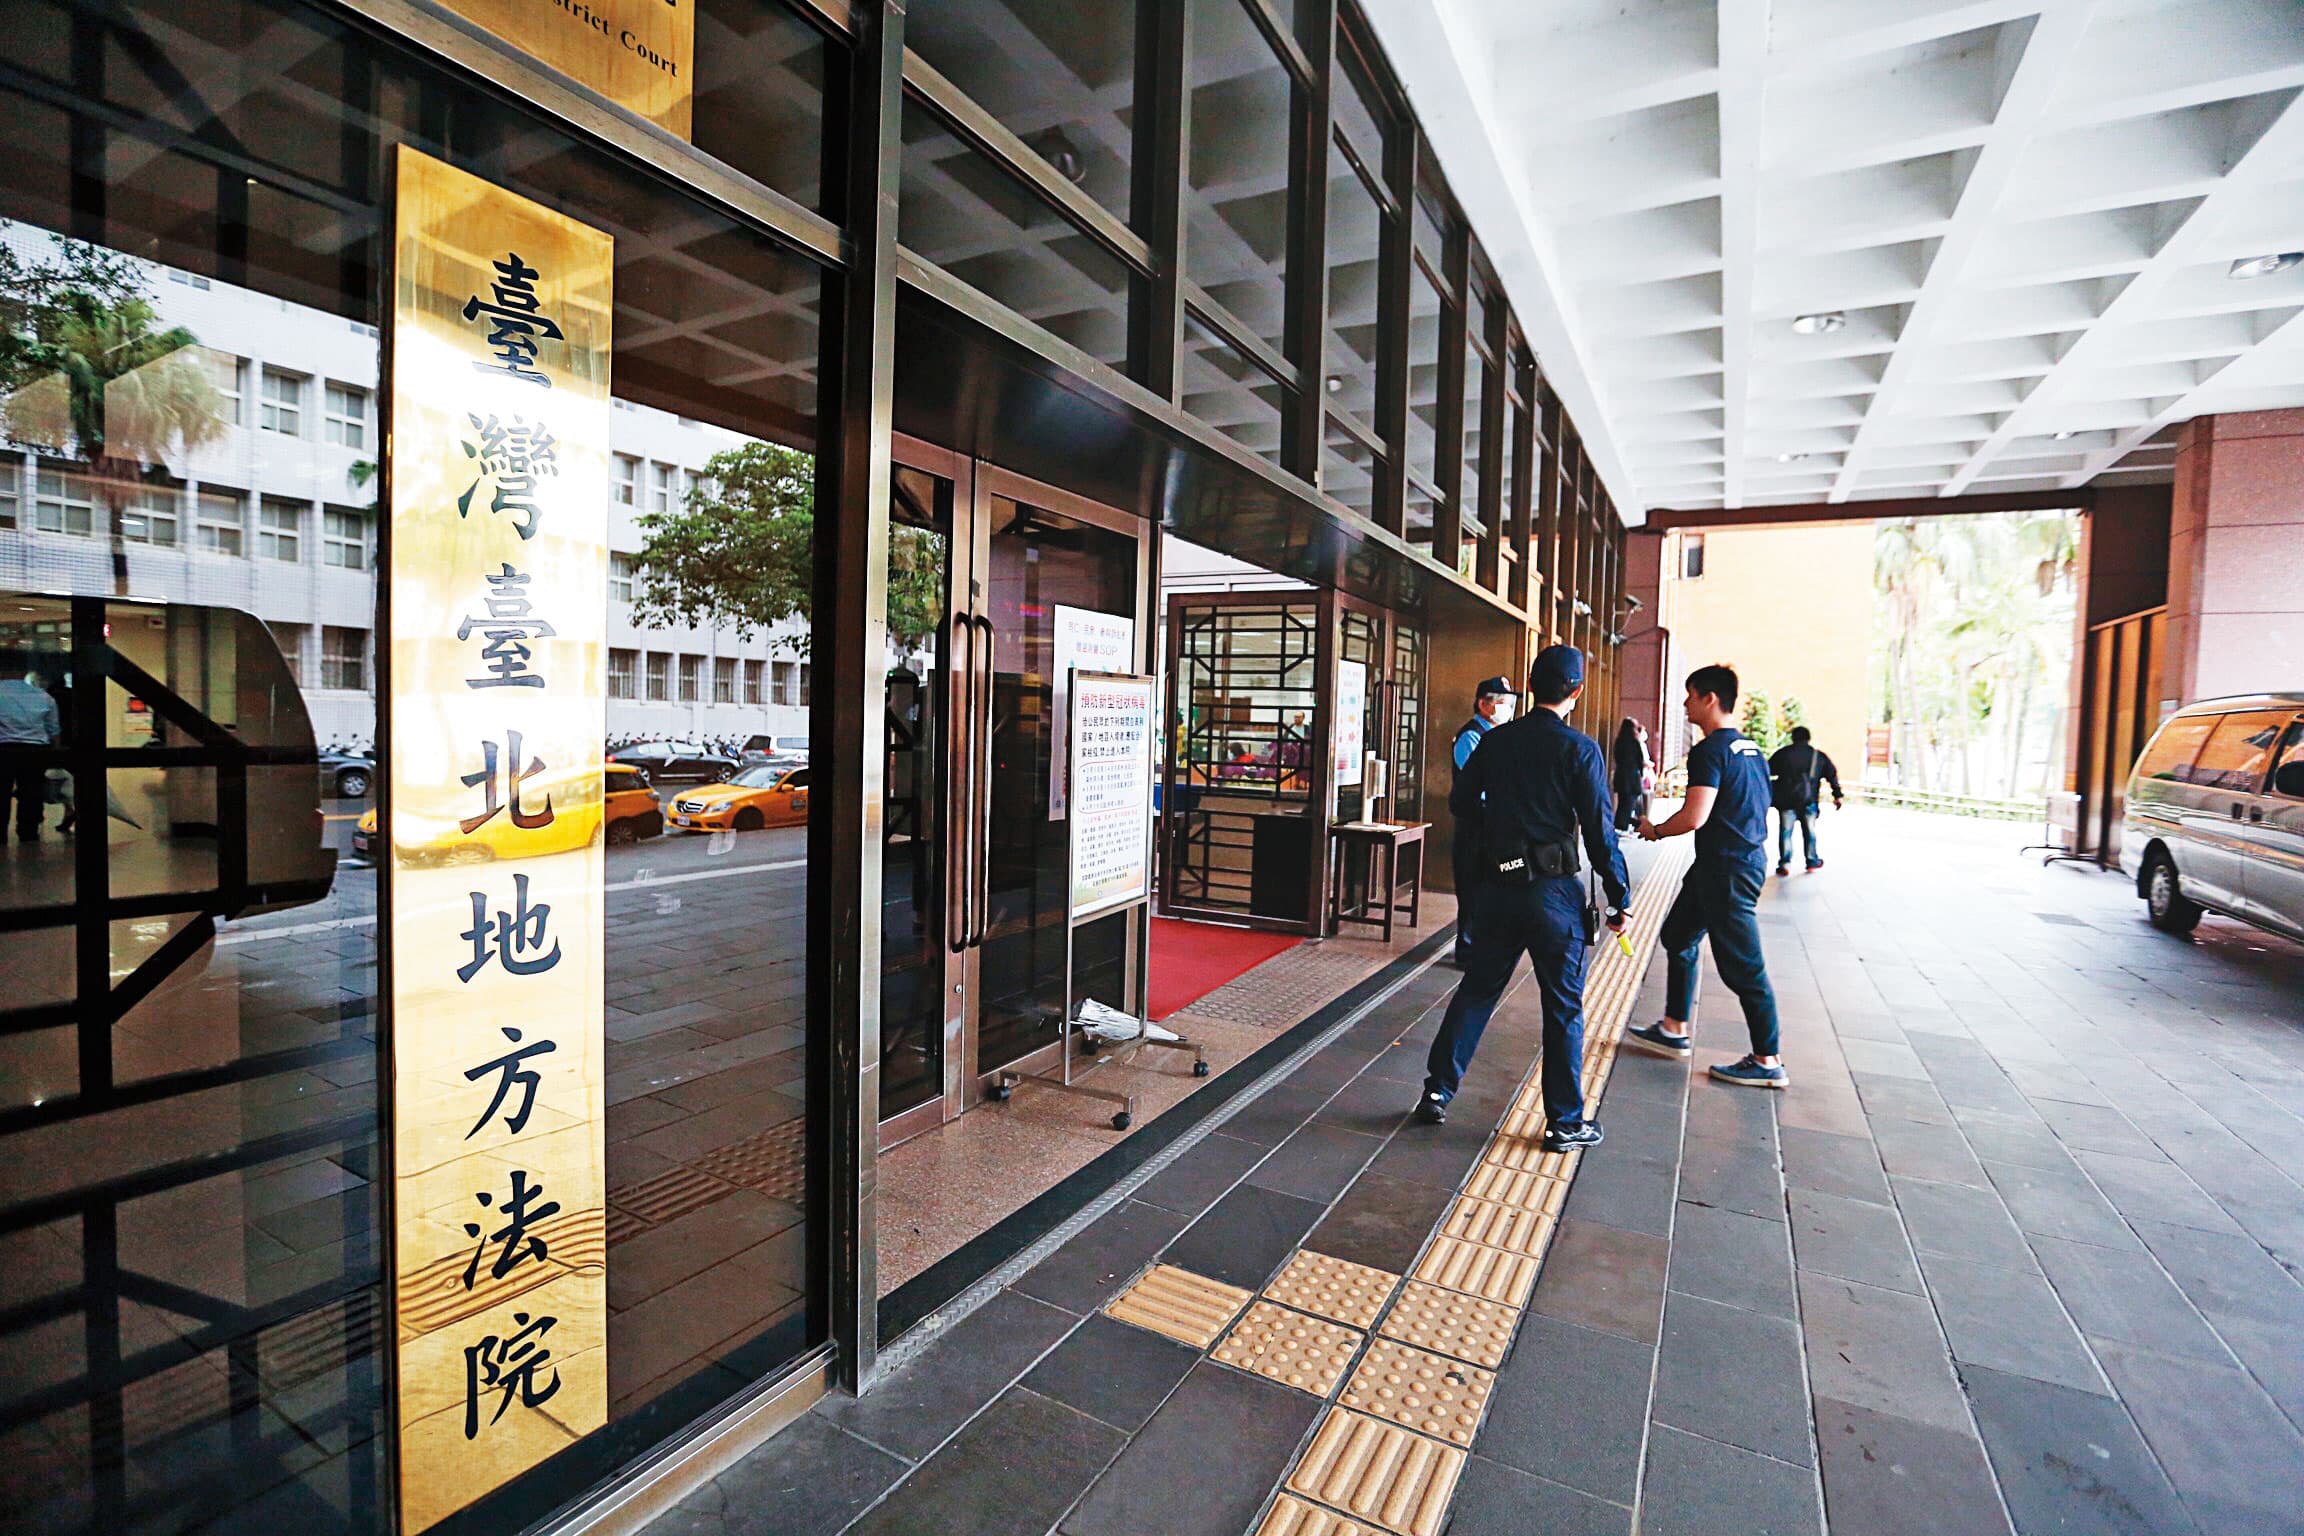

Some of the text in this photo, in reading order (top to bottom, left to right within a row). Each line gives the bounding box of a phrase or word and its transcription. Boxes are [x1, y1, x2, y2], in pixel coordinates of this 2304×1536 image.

[620, 30, 678, 78] Court
[457, 252, 566, 1441] 臺灣臺北地方法院
[1500, 858, 1525, 872] POLICE
